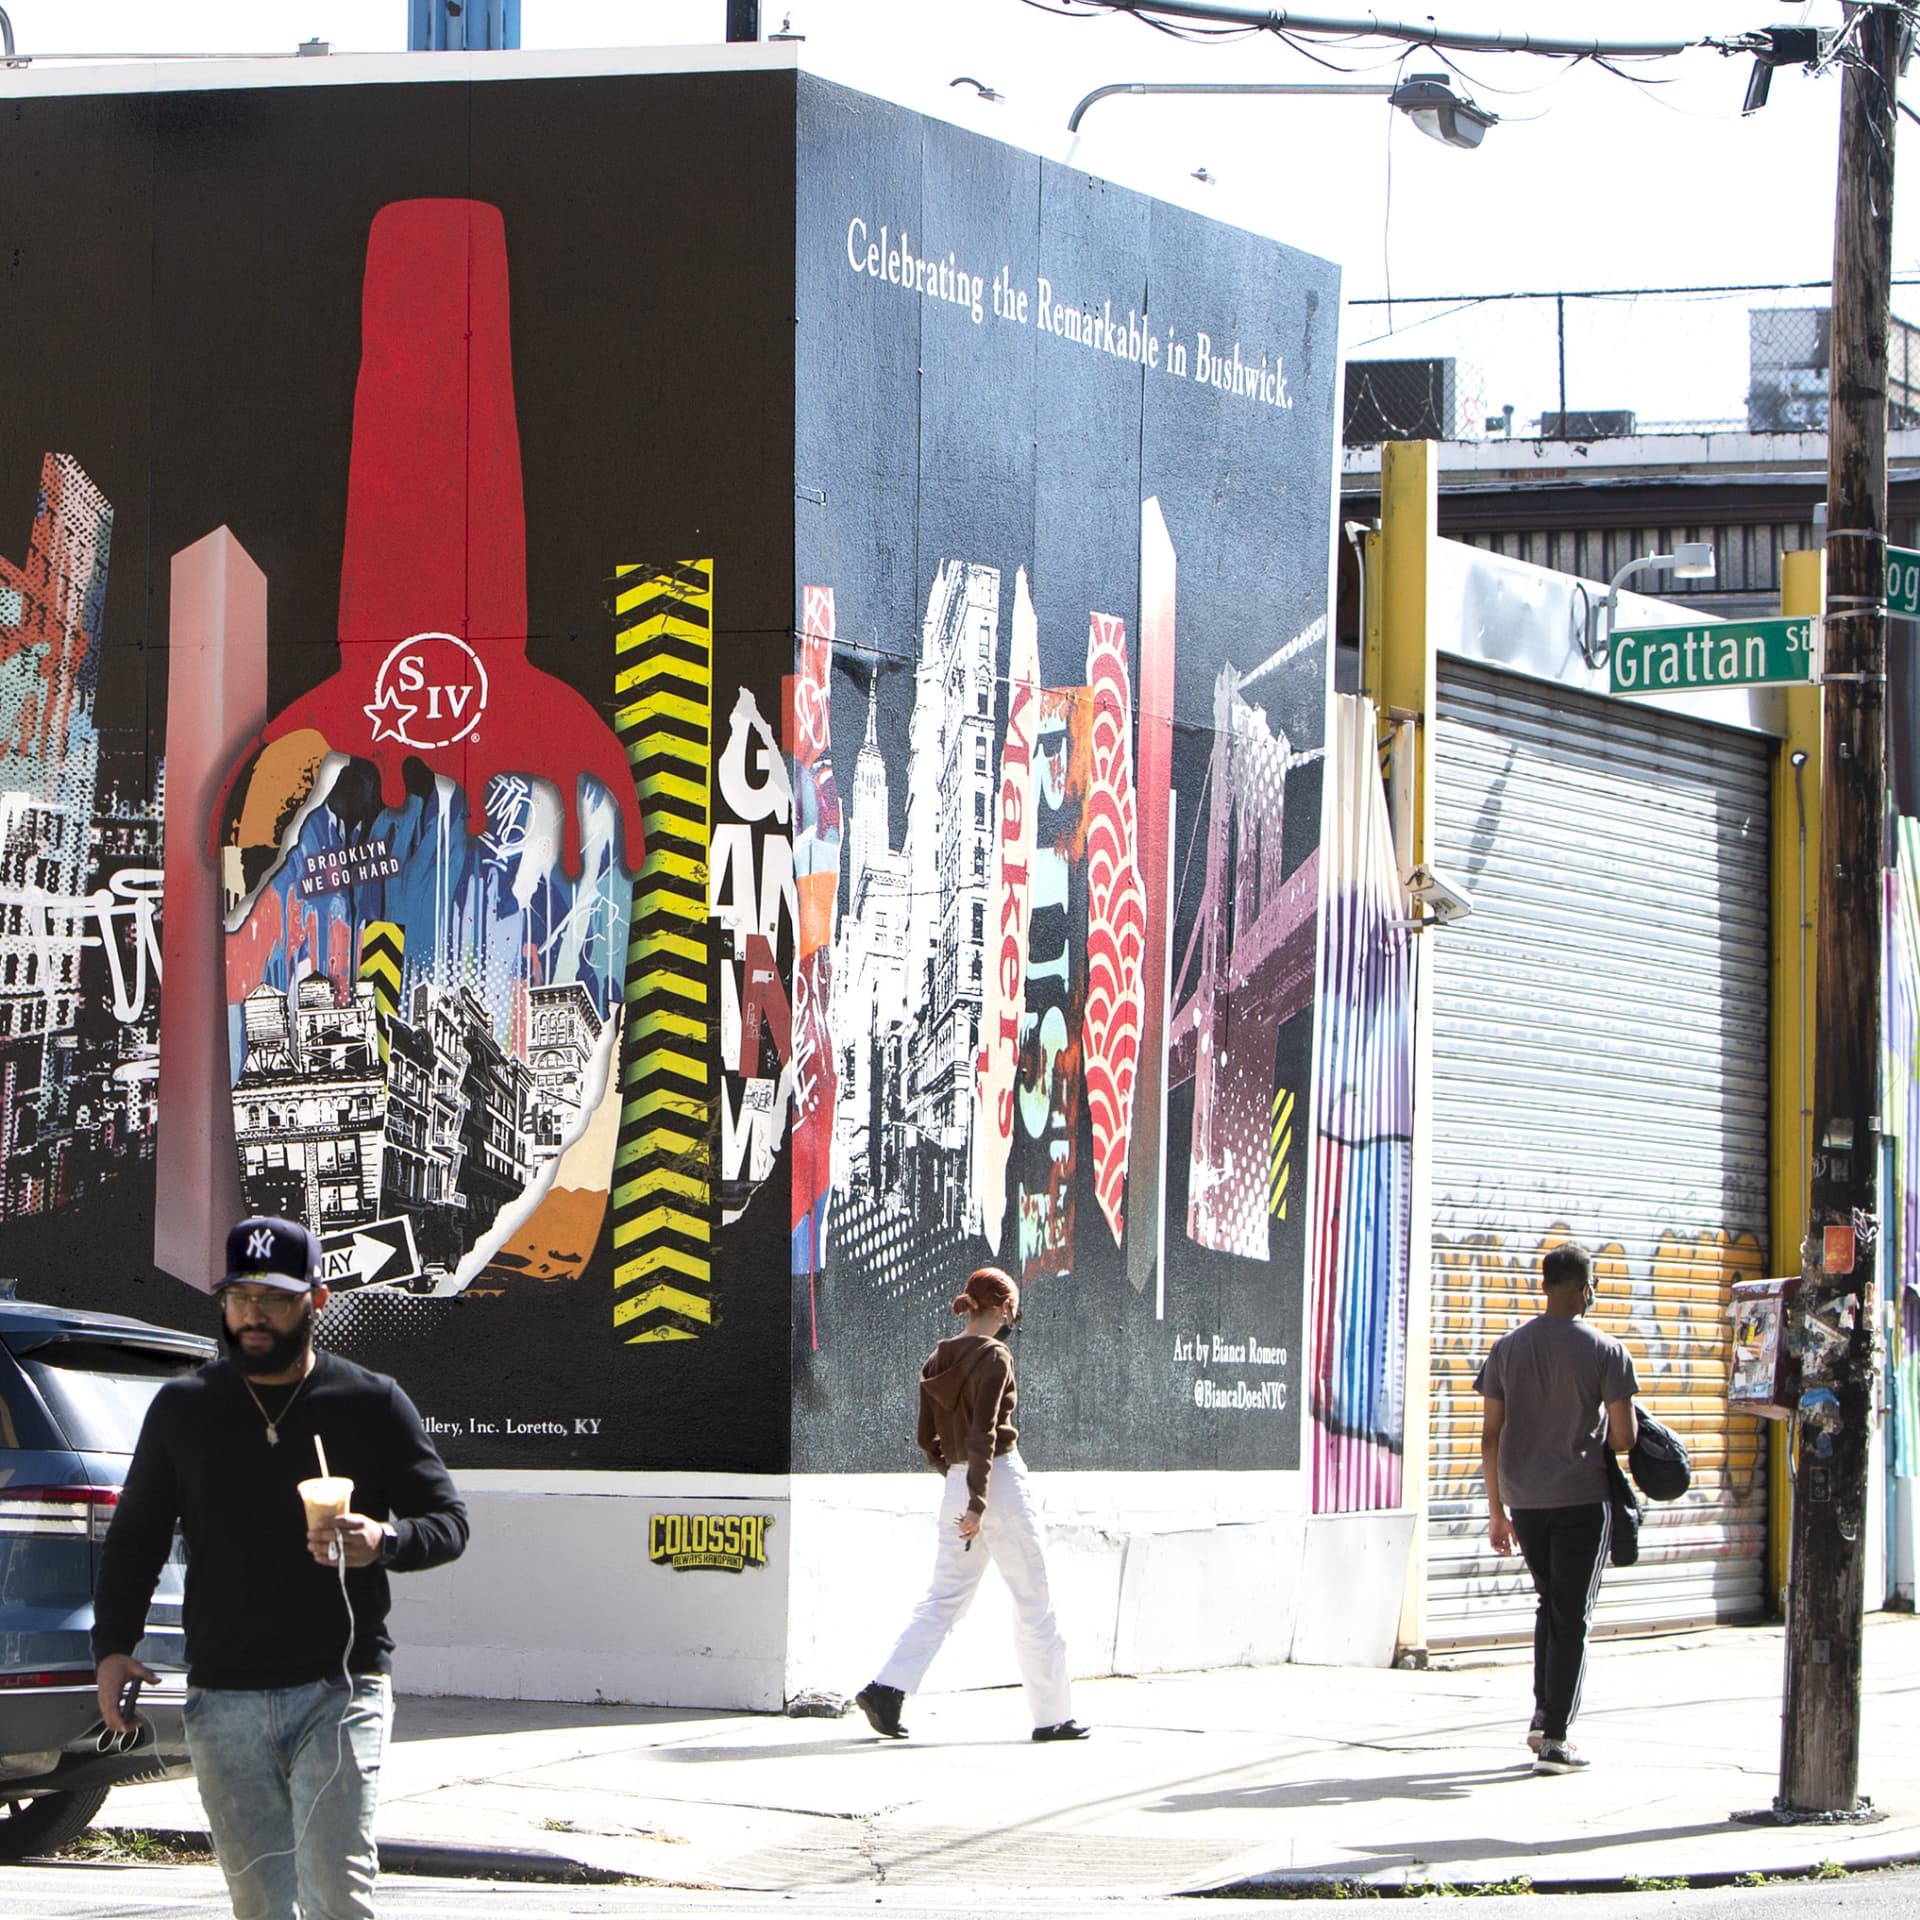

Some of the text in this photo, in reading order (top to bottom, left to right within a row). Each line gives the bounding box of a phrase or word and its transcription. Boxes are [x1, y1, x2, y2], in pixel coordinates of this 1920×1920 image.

[847, 217, 1294, 409] Celebrating the Remarkable in Bushwick.
[398, 655, 425, 692] S
[1615, 625, 1809, 688] Grattan St
[426, 685, 474, 719] IV
[307, 841, 387, 873] BROOKLYN
[302, 858, 399, 894] WE GO HARD
[246, 1228, 276, 1259] NY
[1173, 1333, 1287, 1368] Art by Bianca Romero
[1194, 1380, 1287, 1410] @BiancaDoesNYC
[420, 1417, 602, 1437] illery, Inc. Loretto, KY
[649, 1514, 768, 1564] COLOSSAL
